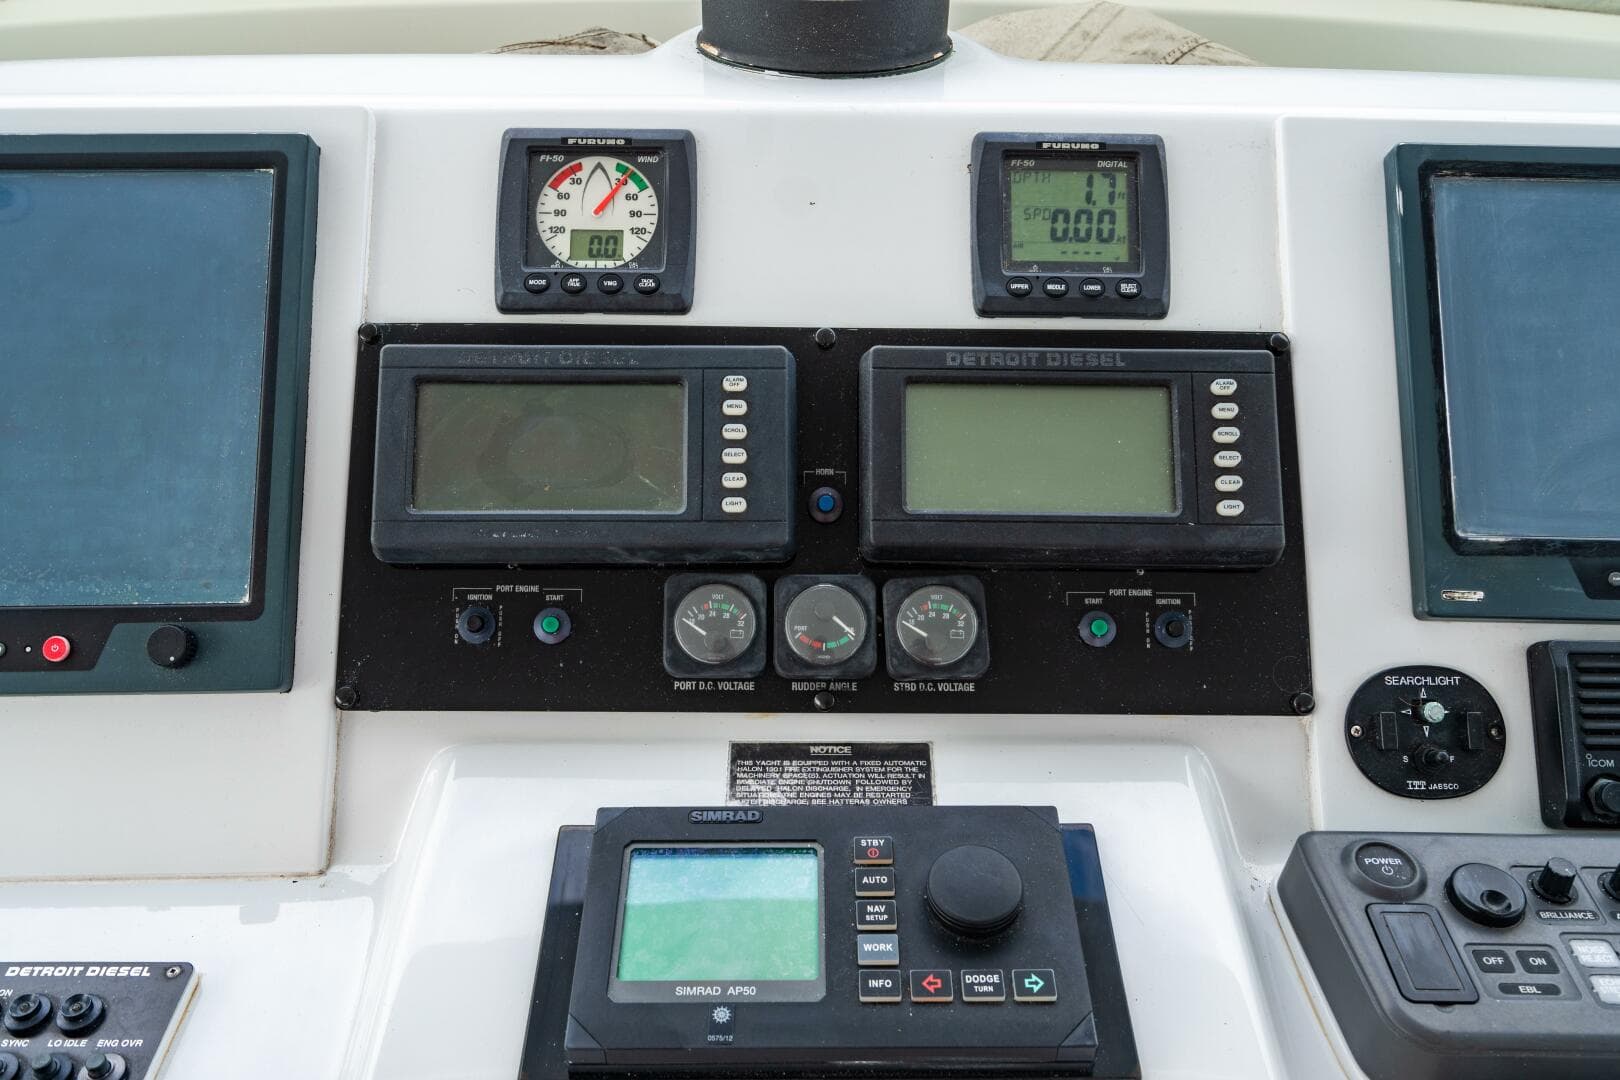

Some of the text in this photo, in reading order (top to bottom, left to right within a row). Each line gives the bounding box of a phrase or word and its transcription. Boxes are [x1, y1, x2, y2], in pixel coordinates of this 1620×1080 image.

[637, 155, 658, 163] WIND
[1097, 160, 1128, 168] DIGITAL
[569, 177, 582, 186] 30
[1013, 172, 1051, 184] DPTH
[557, 192, 570, 200] 60
[625, 193, 638, 201] 60
[553, 209, 567, 217] 90
[629, 210, 642, 218] 90
[1024, 208, 1050, 221] SPD
[1050, 208, 1116, 243] 0.00
[549, 226, 566, 234] 120
[630, 227, 647, 235] 120
[588, 235, 618, 258] 0.0
[946, 351, 1126, 367] DETROIT DIESEL
[515, 585, 539, 593] ENGINE
[1128, 589, 1153, 597] ENGINE
[1384, 676, 1461, 686] SEARCHLIGHT
[674, 682, 755, 691] PORT D.C. VOLTAGE
[791, 682, 858, 691] RUDDER ANGLE
[894, 682, 975, 692] STBD D.C. VOLTAGE
[810, 746, 852, 754] NOTICE
[691, 810, 760, 821] SIMRAD
[861, 839, 885, 847] STBY
[1364, 858, 1402, 866] POWER
[862, 876, 888, 884] AUTO
[867, 905, 886, 913] NAV
[1539, 911, 1595, 920] BRILLIANCE
[1482, 957, 1504, 965] OFF
[1529, 958, 1547, 966] ON
[5, 966, 150, 977] DETROIT DIESEL
[965, 975, 1000, 984] DODGE
[868, 980, 892, 988] INFO
[727, 986, 756, 996] AP50
[1518, 986, 1541, 994] EBL
[0, 1039, 29, 1047] SYNC
